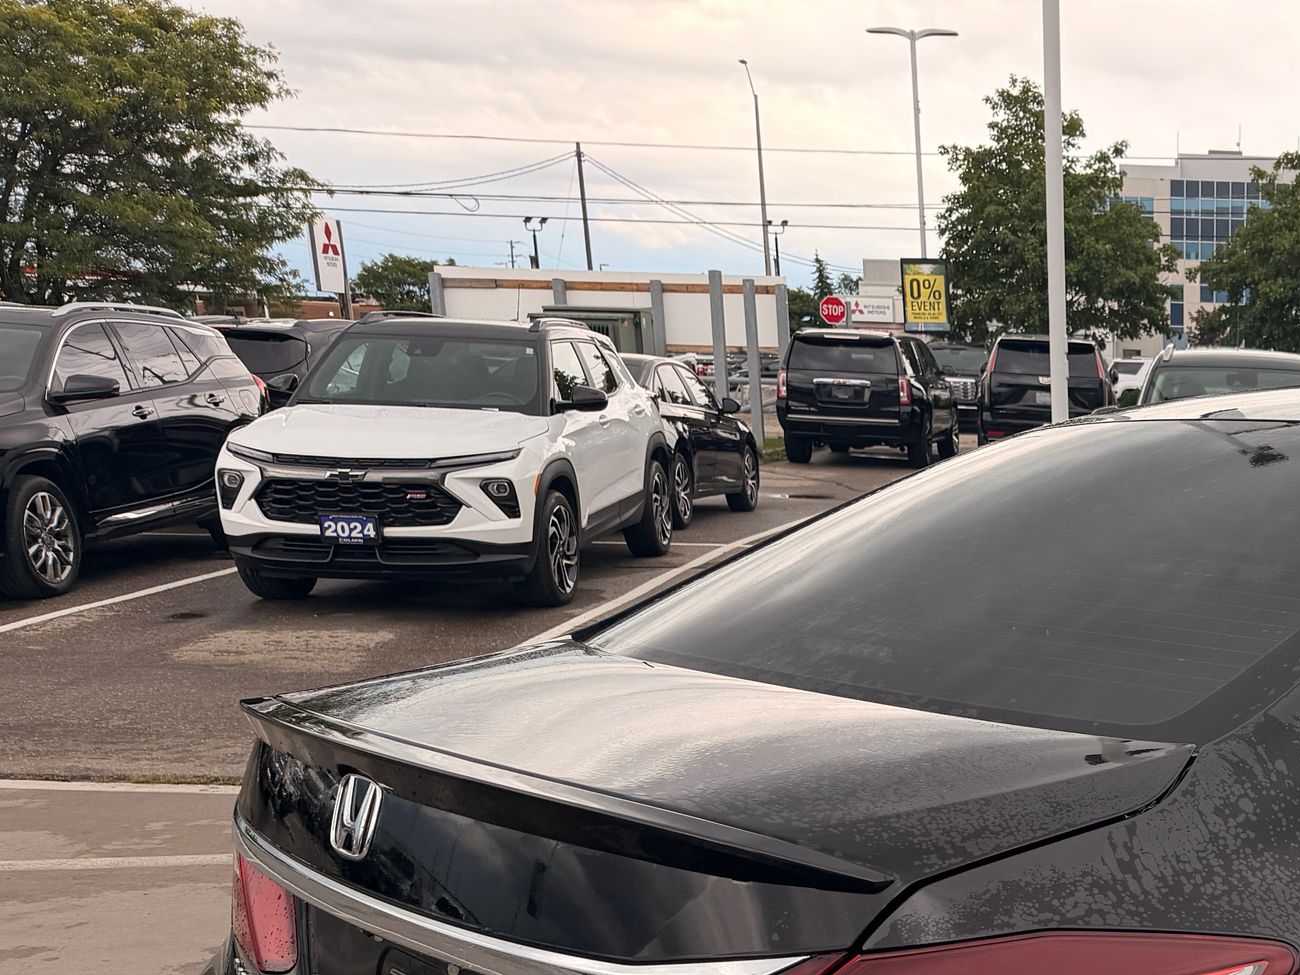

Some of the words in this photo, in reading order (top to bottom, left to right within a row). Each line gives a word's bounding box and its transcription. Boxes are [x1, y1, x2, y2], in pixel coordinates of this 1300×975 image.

[910, 278, 942, 300] 0%
[822, 304, 844, 316] STOP
[911, 300, 941, 311] EVENT
[323, 521, 376, 538] 2024
